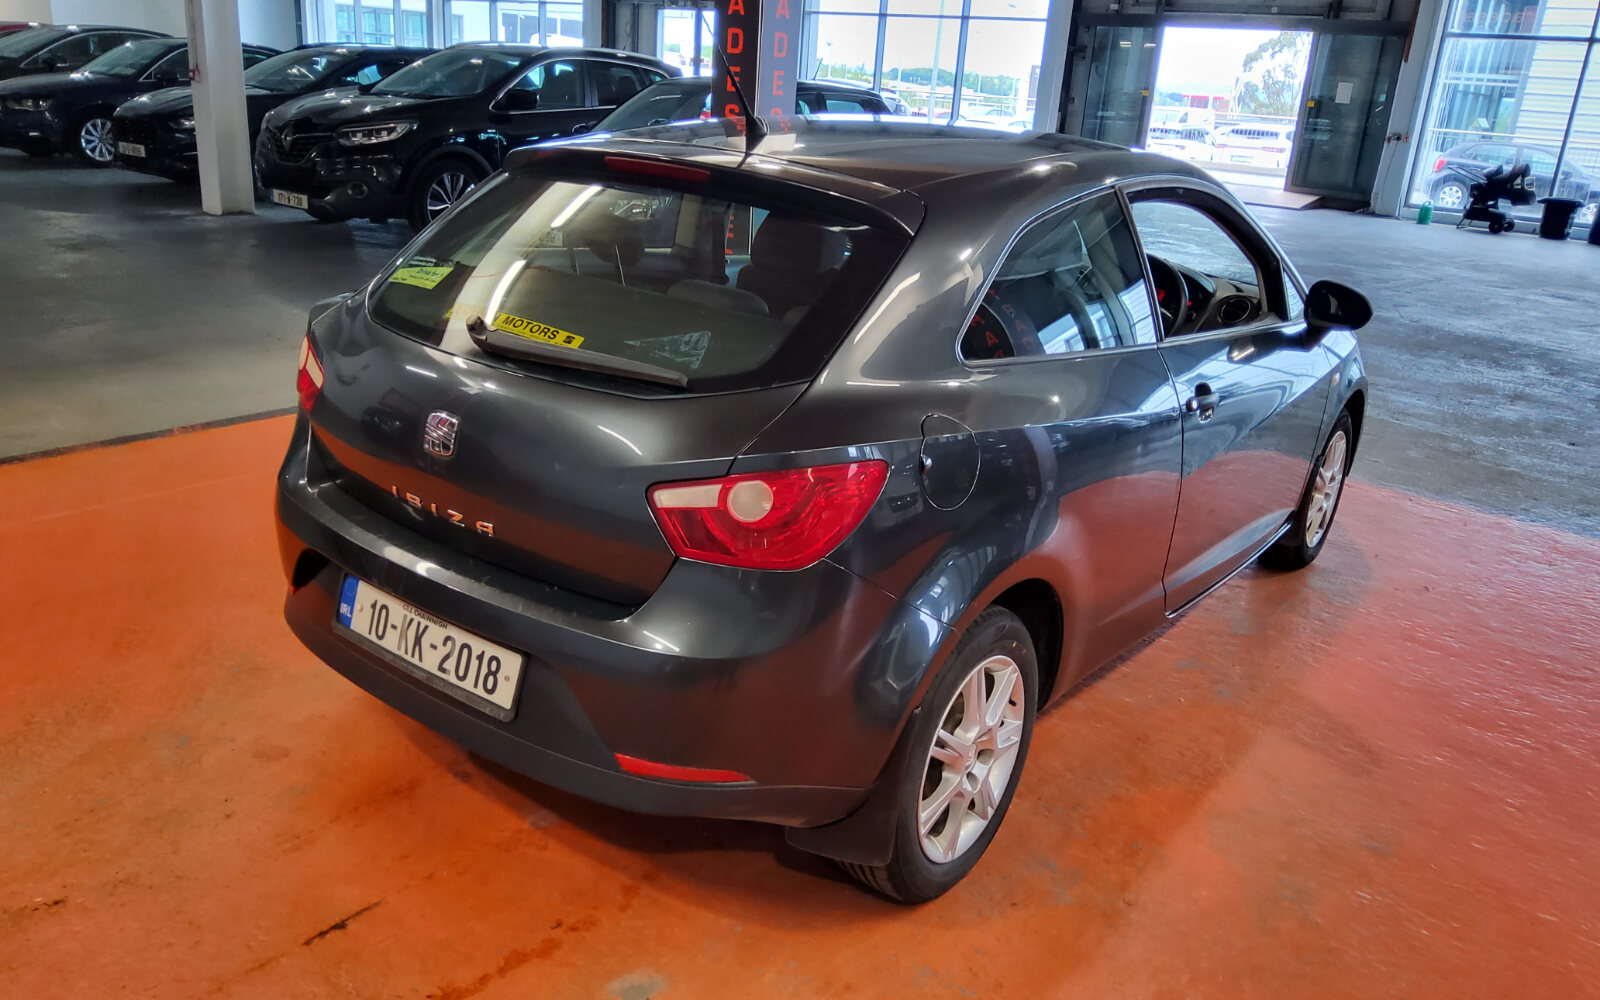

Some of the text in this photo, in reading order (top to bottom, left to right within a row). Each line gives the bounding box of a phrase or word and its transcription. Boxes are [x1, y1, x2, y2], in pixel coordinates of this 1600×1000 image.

[501, 315, 559, 340] MOTORS
[392, 485, 494, 537] IBIZA
[339, 602, 352, 617] IRL
[368, 600, 502, 696] 10-KK-2018
